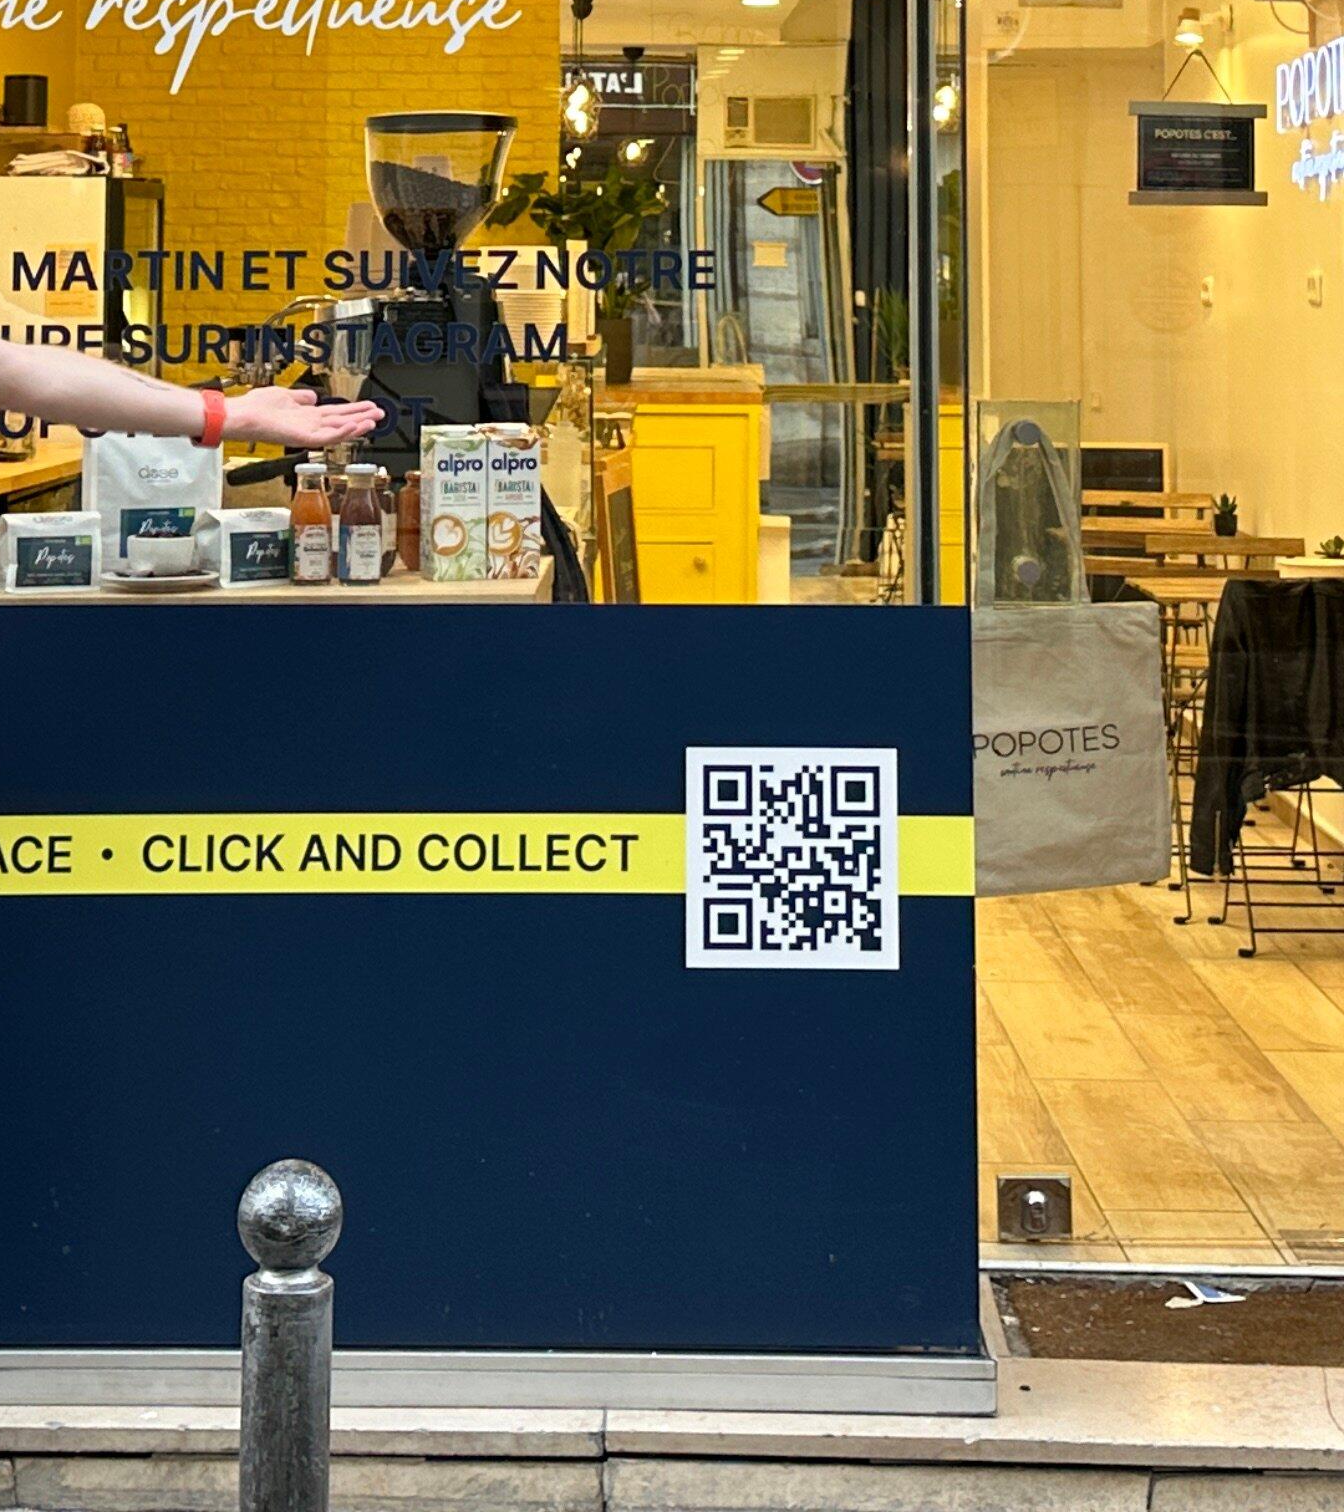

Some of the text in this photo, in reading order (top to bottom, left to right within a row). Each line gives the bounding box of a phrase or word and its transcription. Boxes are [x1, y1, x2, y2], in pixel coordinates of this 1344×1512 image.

[12, 250, 225, 291] MARTIN
[243, 250, 307, 290] ET
[323, 249, 518, 291] SUIVEZ
[536, 249, 716, 290] NOTRE
[120, 322, 229, 365] SUR
[244, 321, 568, 365] INSTAGRAM
[437, 453, 484, 477] alpro
[491, 451, 538, 475] alpro
[972, 723, 1120, 759] POPOTES
[141, 834, 285, 874] CLICK
[298, 834, 403, 874] AND
[416, 833, 640, 874] COLLECT
